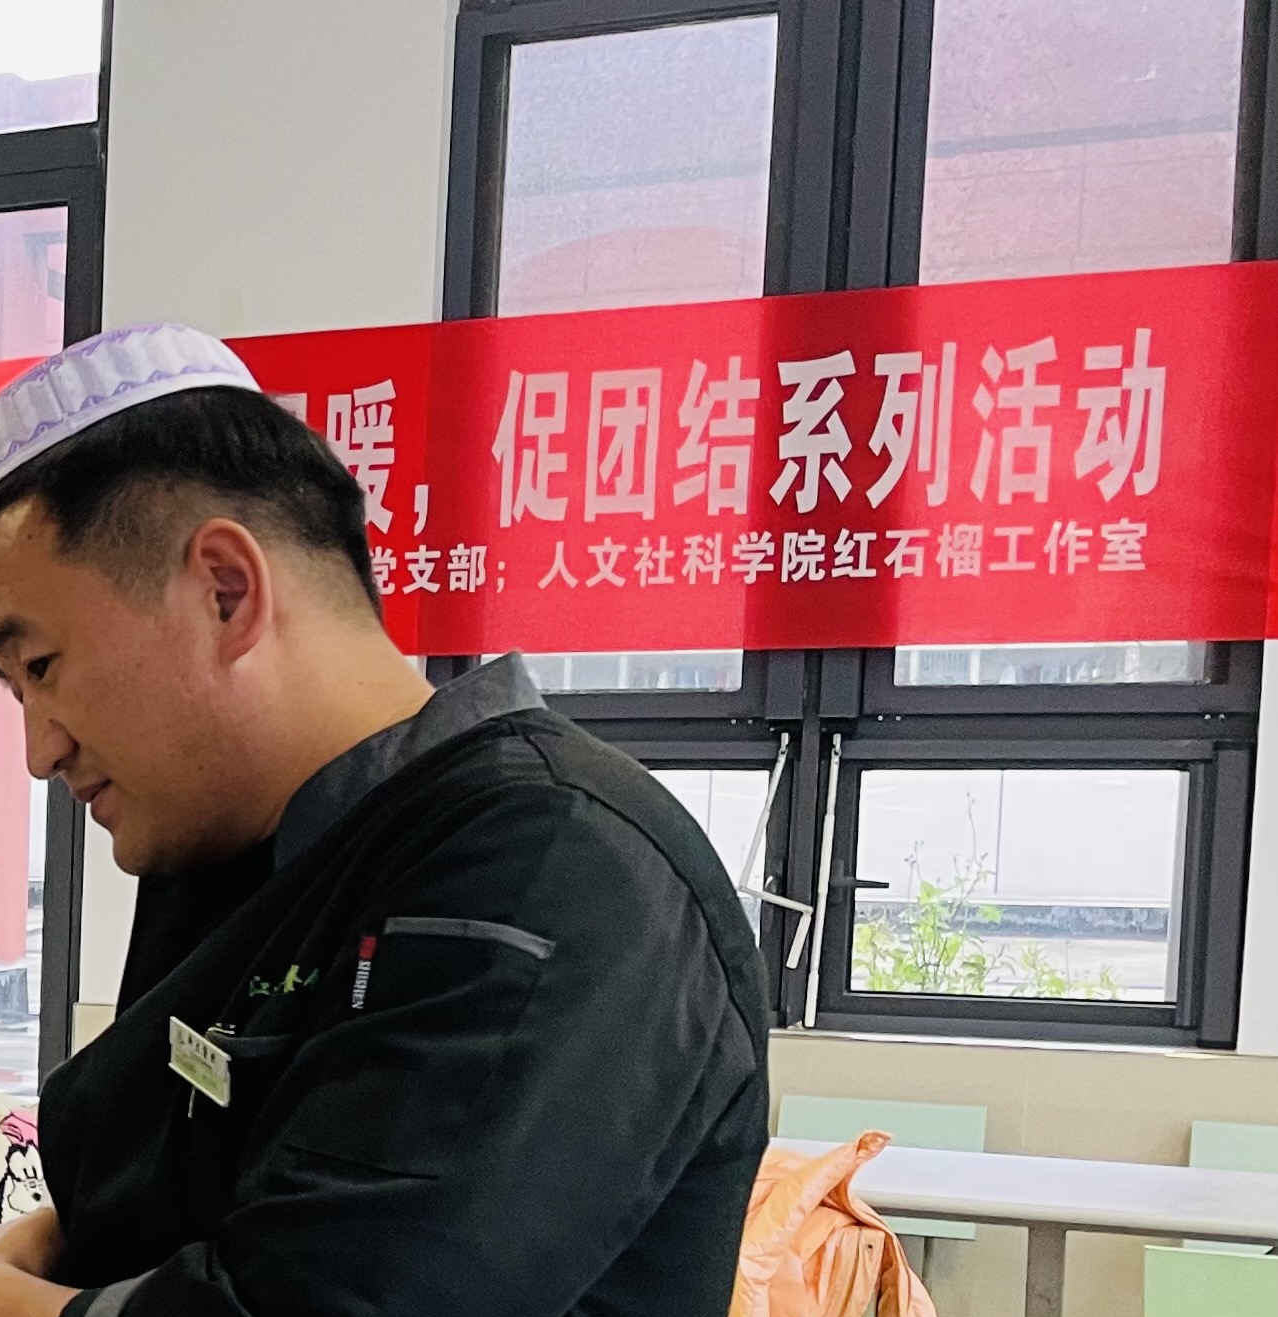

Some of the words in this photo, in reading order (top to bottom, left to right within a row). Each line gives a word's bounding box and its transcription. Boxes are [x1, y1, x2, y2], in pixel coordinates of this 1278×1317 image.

[267, 328, 1166, 536] 暖，促团结系列活动
